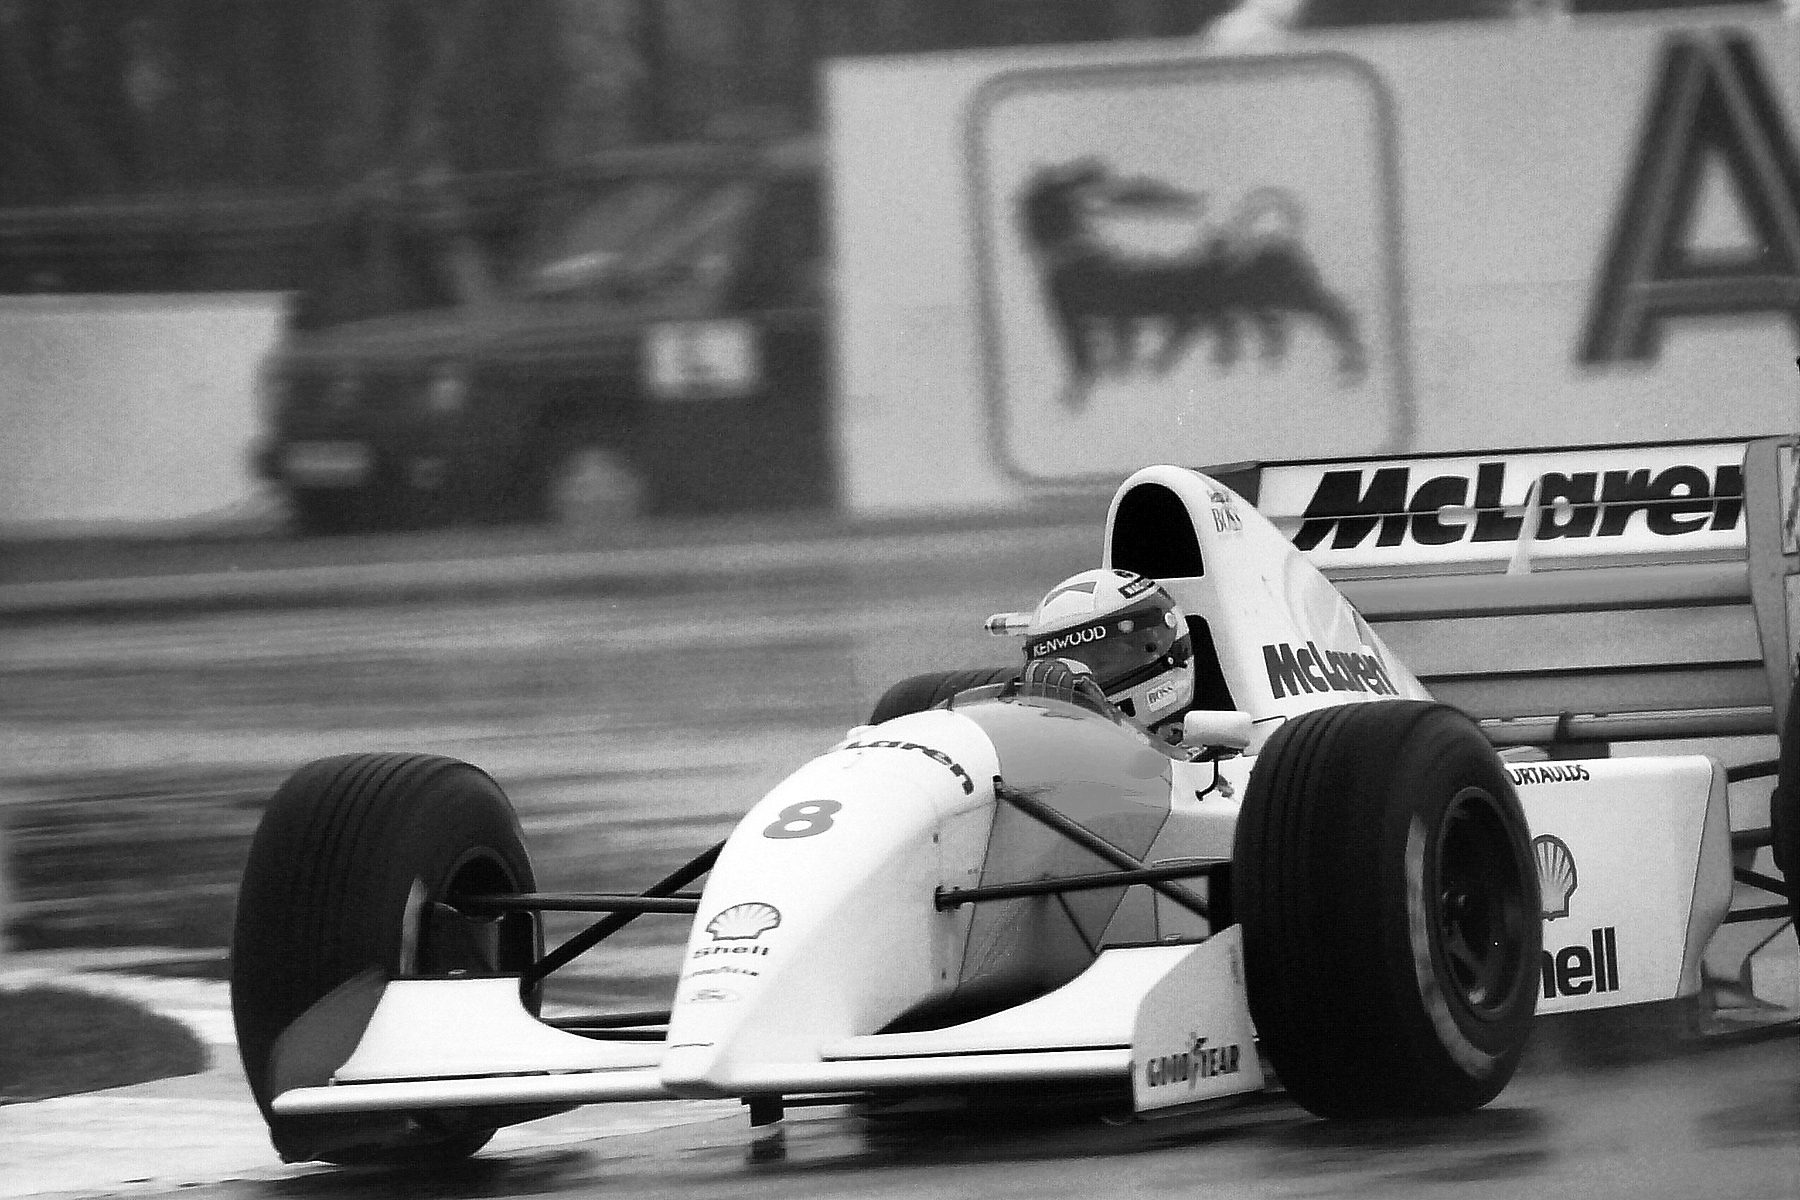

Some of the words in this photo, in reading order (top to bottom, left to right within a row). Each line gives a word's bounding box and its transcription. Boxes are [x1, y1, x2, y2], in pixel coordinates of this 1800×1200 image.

[1033, 625, 1106, 657] KENWOOD
[1262, 641, 1399, 699] McLaren
[845, 741, 975, 795] Laren
[1507, 764, 1590, 785] URTAULDS
[763, 800, 842, 839] 8
